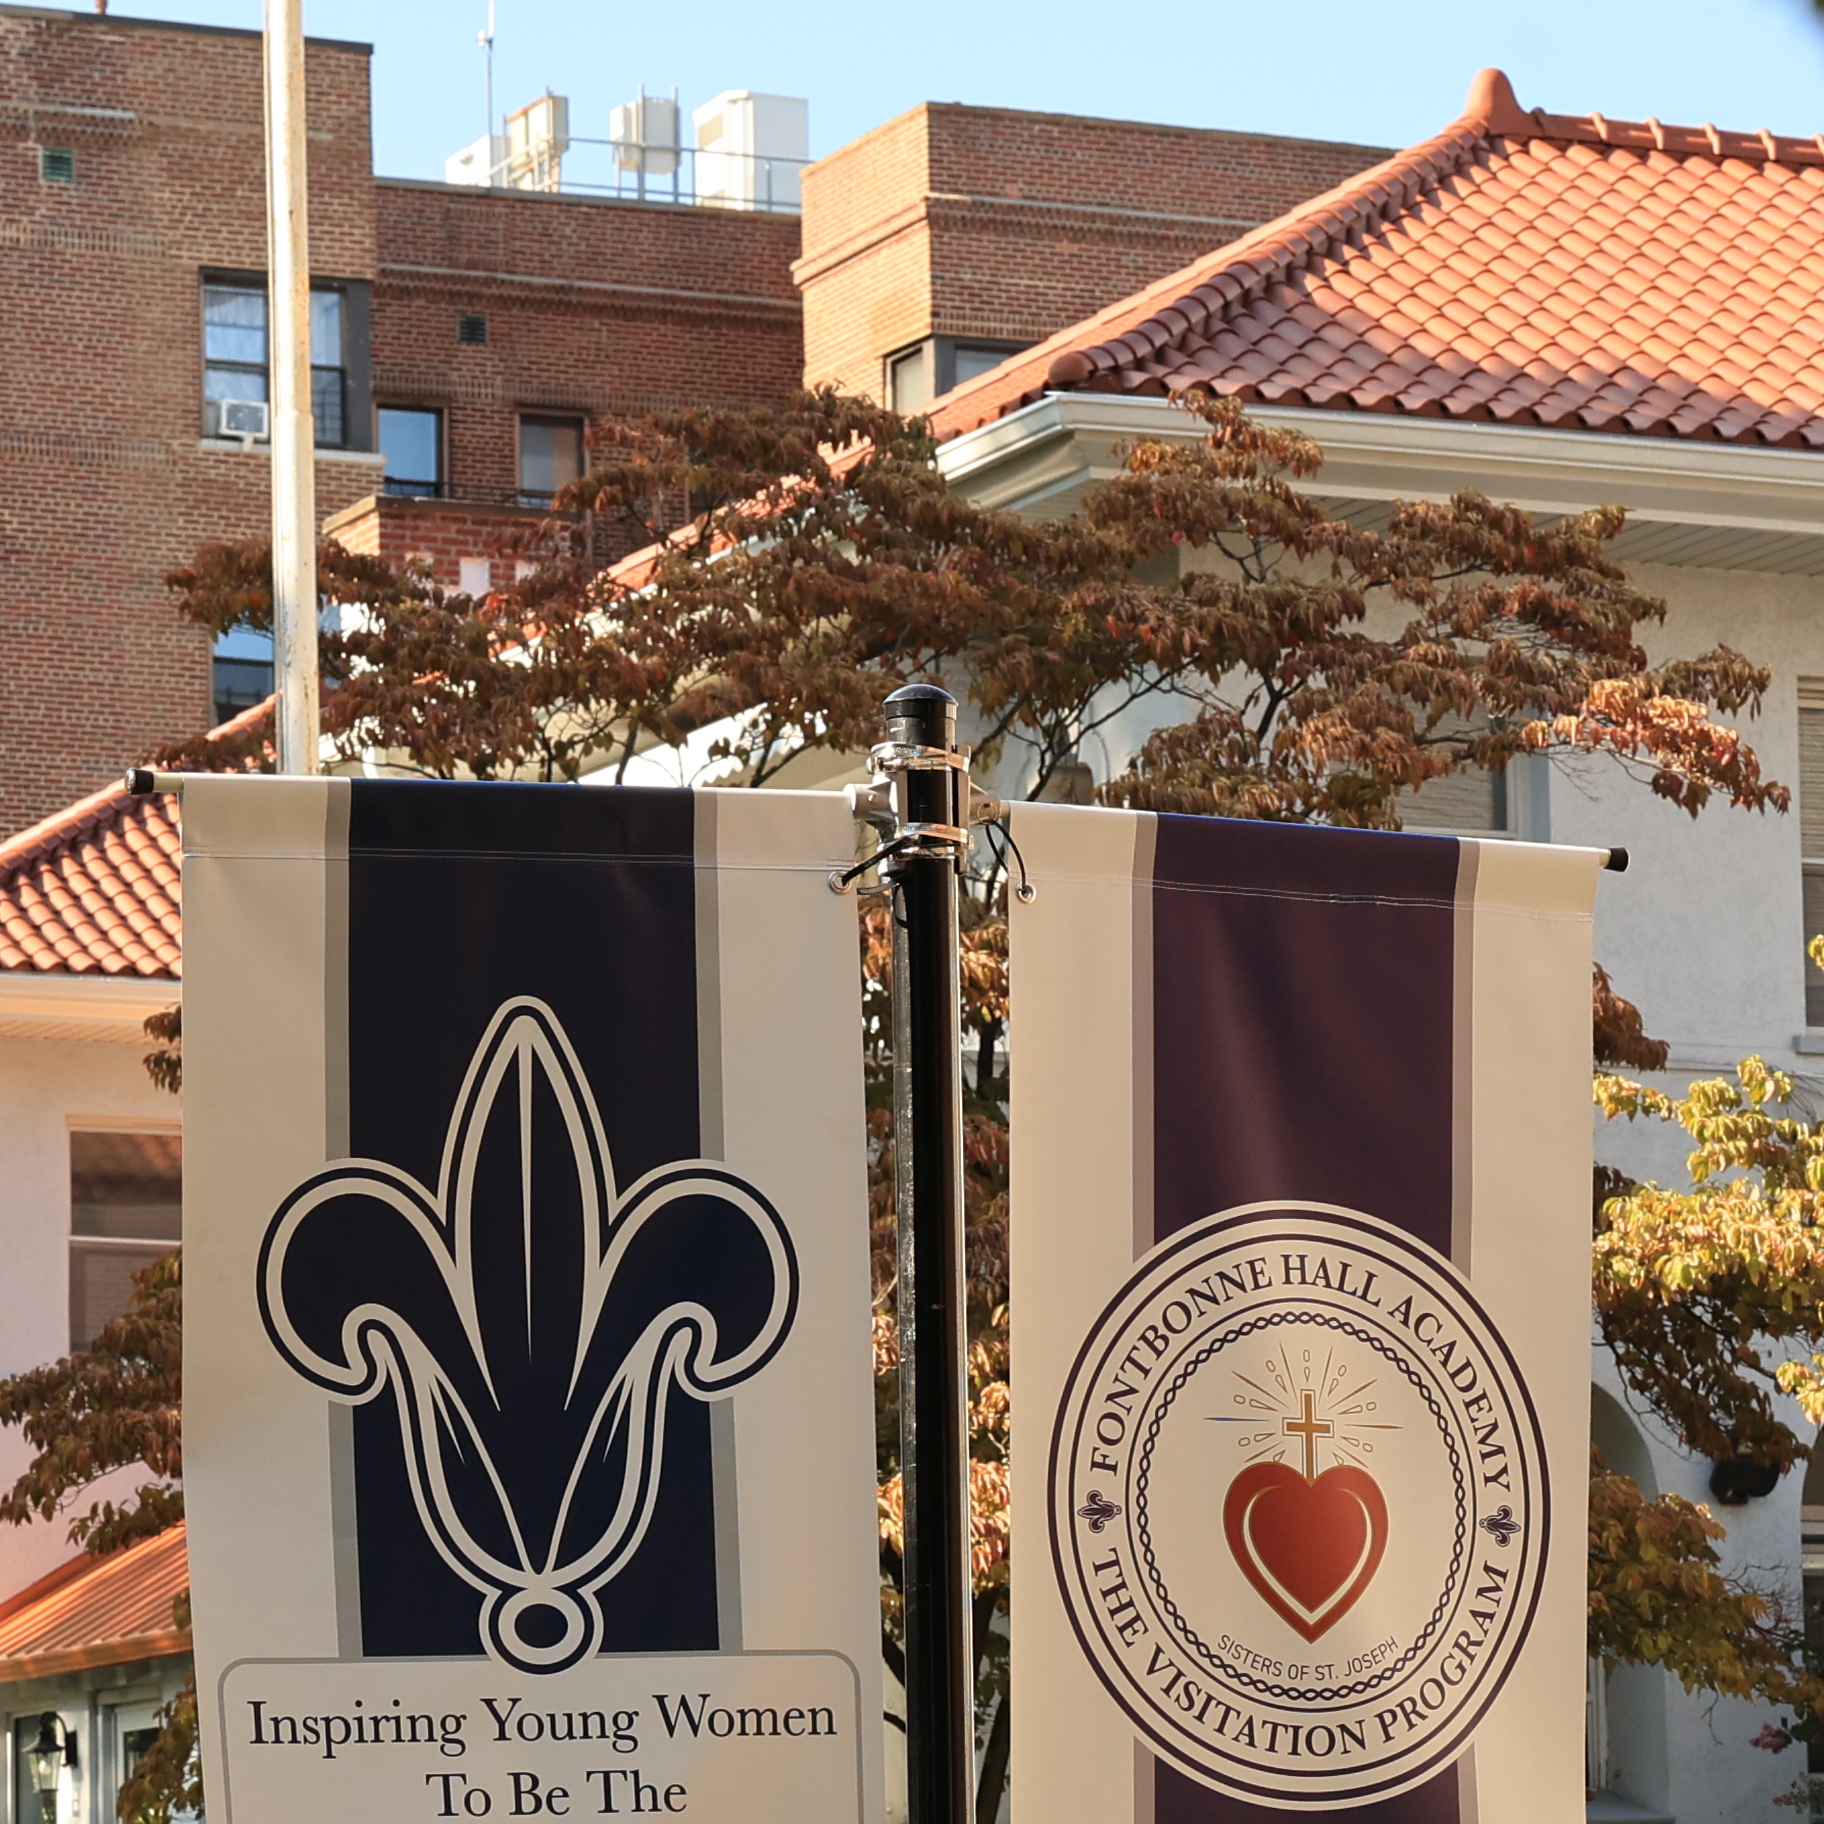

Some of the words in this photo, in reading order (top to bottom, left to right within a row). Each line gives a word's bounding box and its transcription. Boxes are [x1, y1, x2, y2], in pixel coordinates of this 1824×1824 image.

[1090, 1257, 1272, 1477] FONTBONNE
[1281, 1253, 1383, 1308] HALL
[1387, 1294, 1511, 1493] ACADEMY
[1092, 1548, 1149, 1649] THE
[1144, 1643, 1368, 1758] VISITATION
[1374, 1560, 1509, 1743] PROGRAM
[1217, 1634, 1284, 1679] SISTERS
[1288, 1664, 1310, 1681] OF
[1315, 1662, 1339, 1681] ST.
[1343, 1636, 1399, 1678] JOSEPH
[247, 1699, 467, 1759] Inspiring
[480, 1698, 639, 1753] Young
[652, 1693, 837, 1739] Women
[426, 1772, 492, 1817] To
[508, 1772, 570, 1815] Be
[586, 1769, 687, 1813] The
